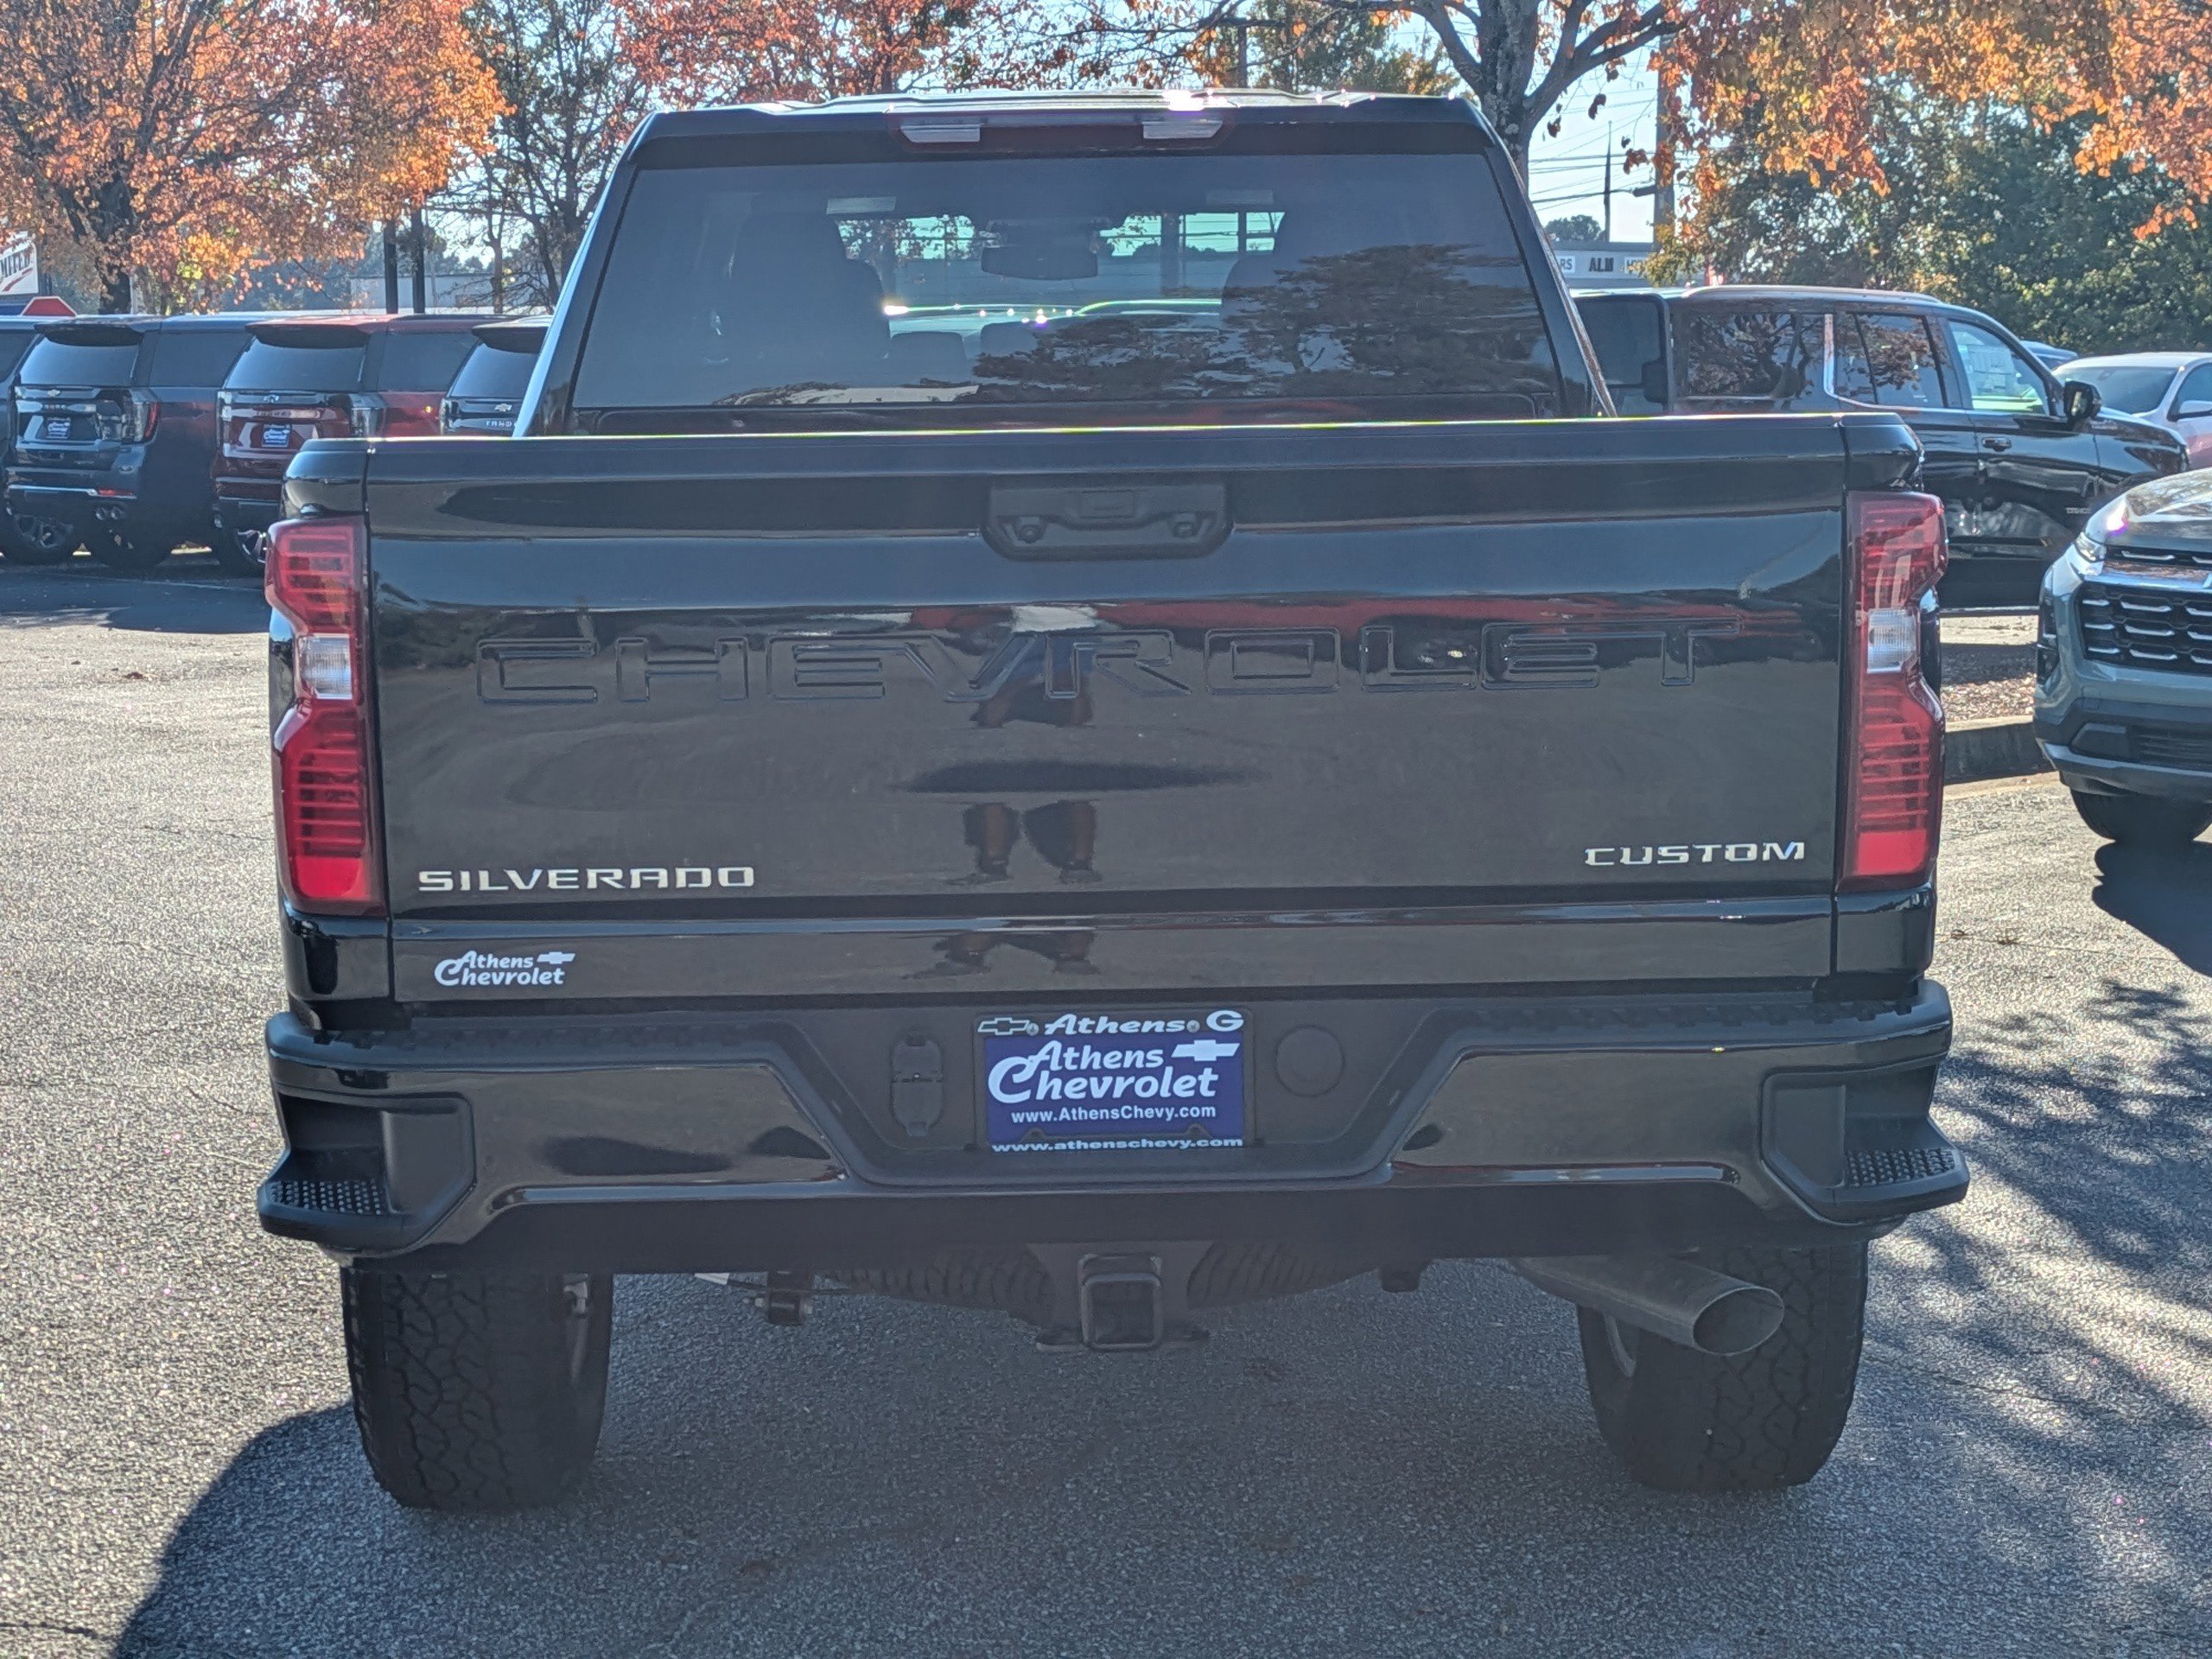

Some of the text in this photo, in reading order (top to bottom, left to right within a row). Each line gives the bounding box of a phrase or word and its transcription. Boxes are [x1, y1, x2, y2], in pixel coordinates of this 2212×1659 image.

[476, 614, 1743, 704] CHEVROLET
[1585, 841, 1806, 866] CUSTOM
[417, 866, 755, 892] SILVERADO
[434, 958, 566, 987] Chevrolet
[456, 950, 534, 969] Athens
[1044, 1009, 1244, 1036] Athens G
[1030, 1039, 1165, 1072] Athens
[988, 1055, 1219, 1104] Chevrolet
[1010, 1104, 1217, 1124] www.AthensChevy.com
[991, 1136, 1244, 1154] www.athenschevy.com
